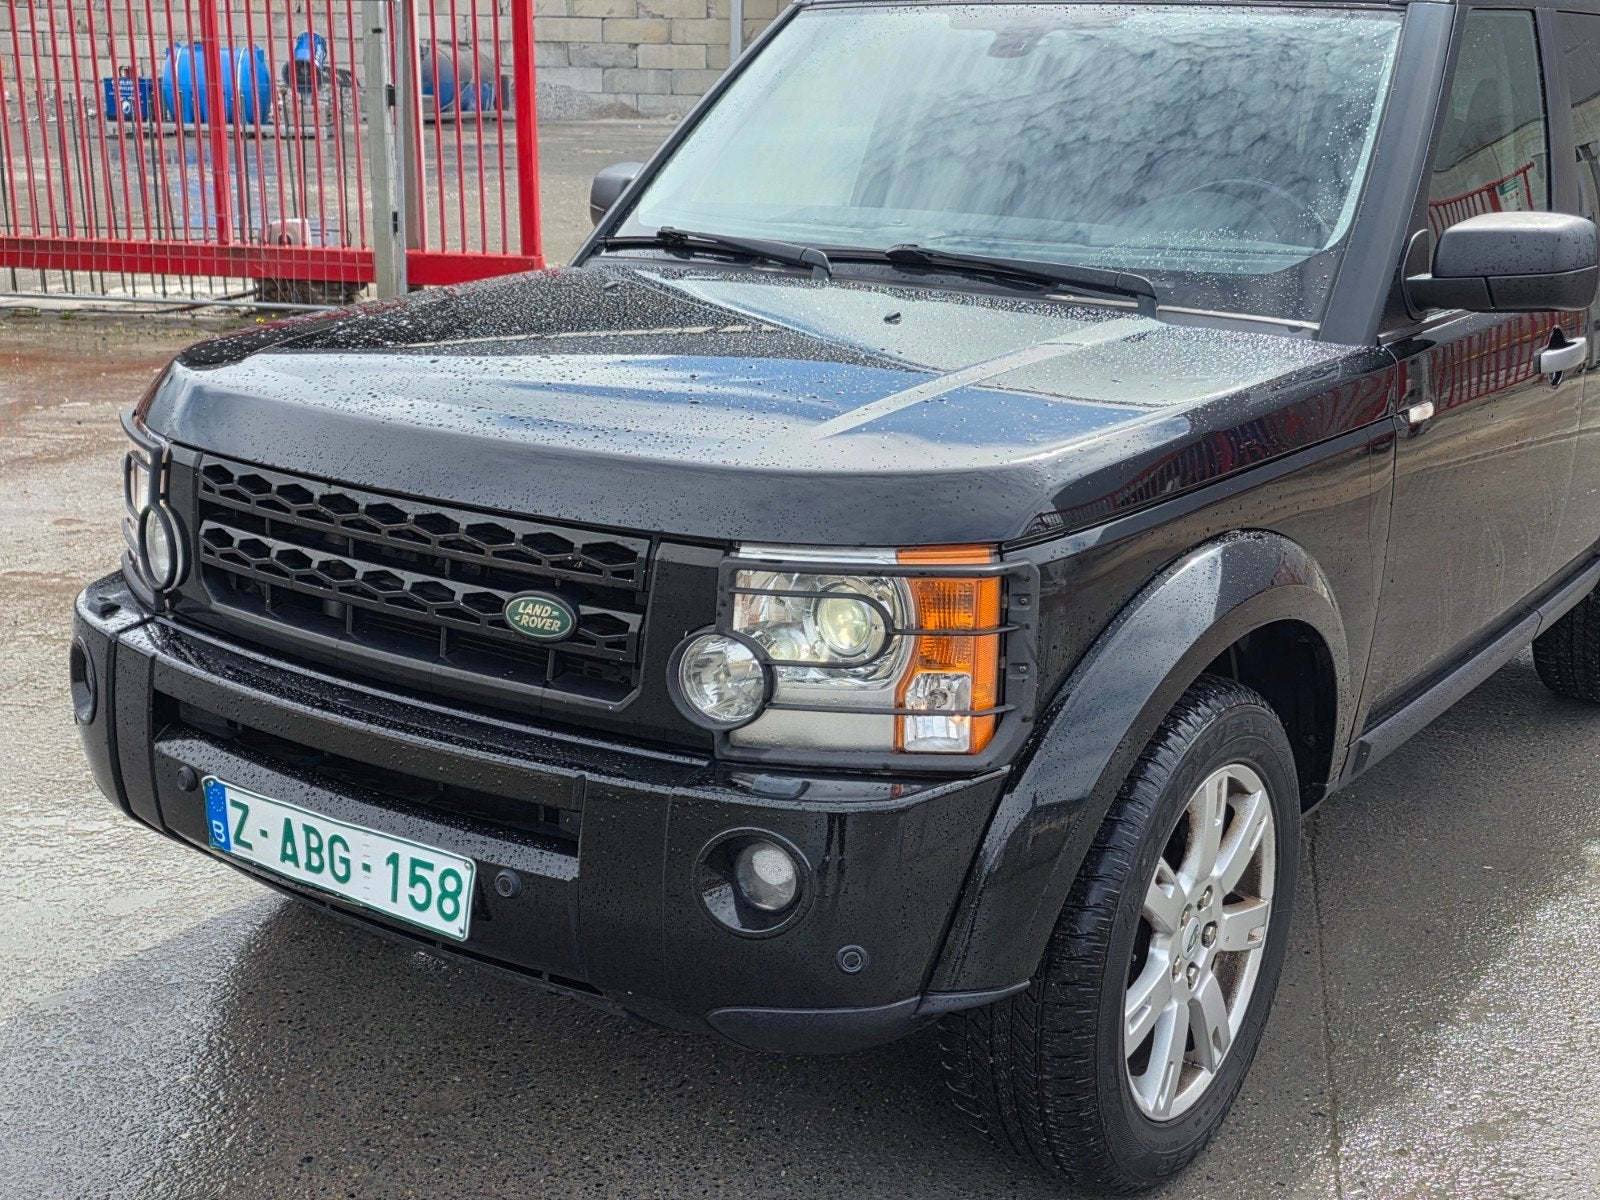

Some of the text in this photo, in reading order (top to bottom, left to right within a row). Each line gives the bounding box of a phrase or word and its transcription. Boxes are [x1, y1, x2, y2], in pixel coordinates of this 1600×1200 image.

[518, 602, 552, 617] LAND
[520, 615, 561, 631] ROVER
[212, 820, 226, 843] B
